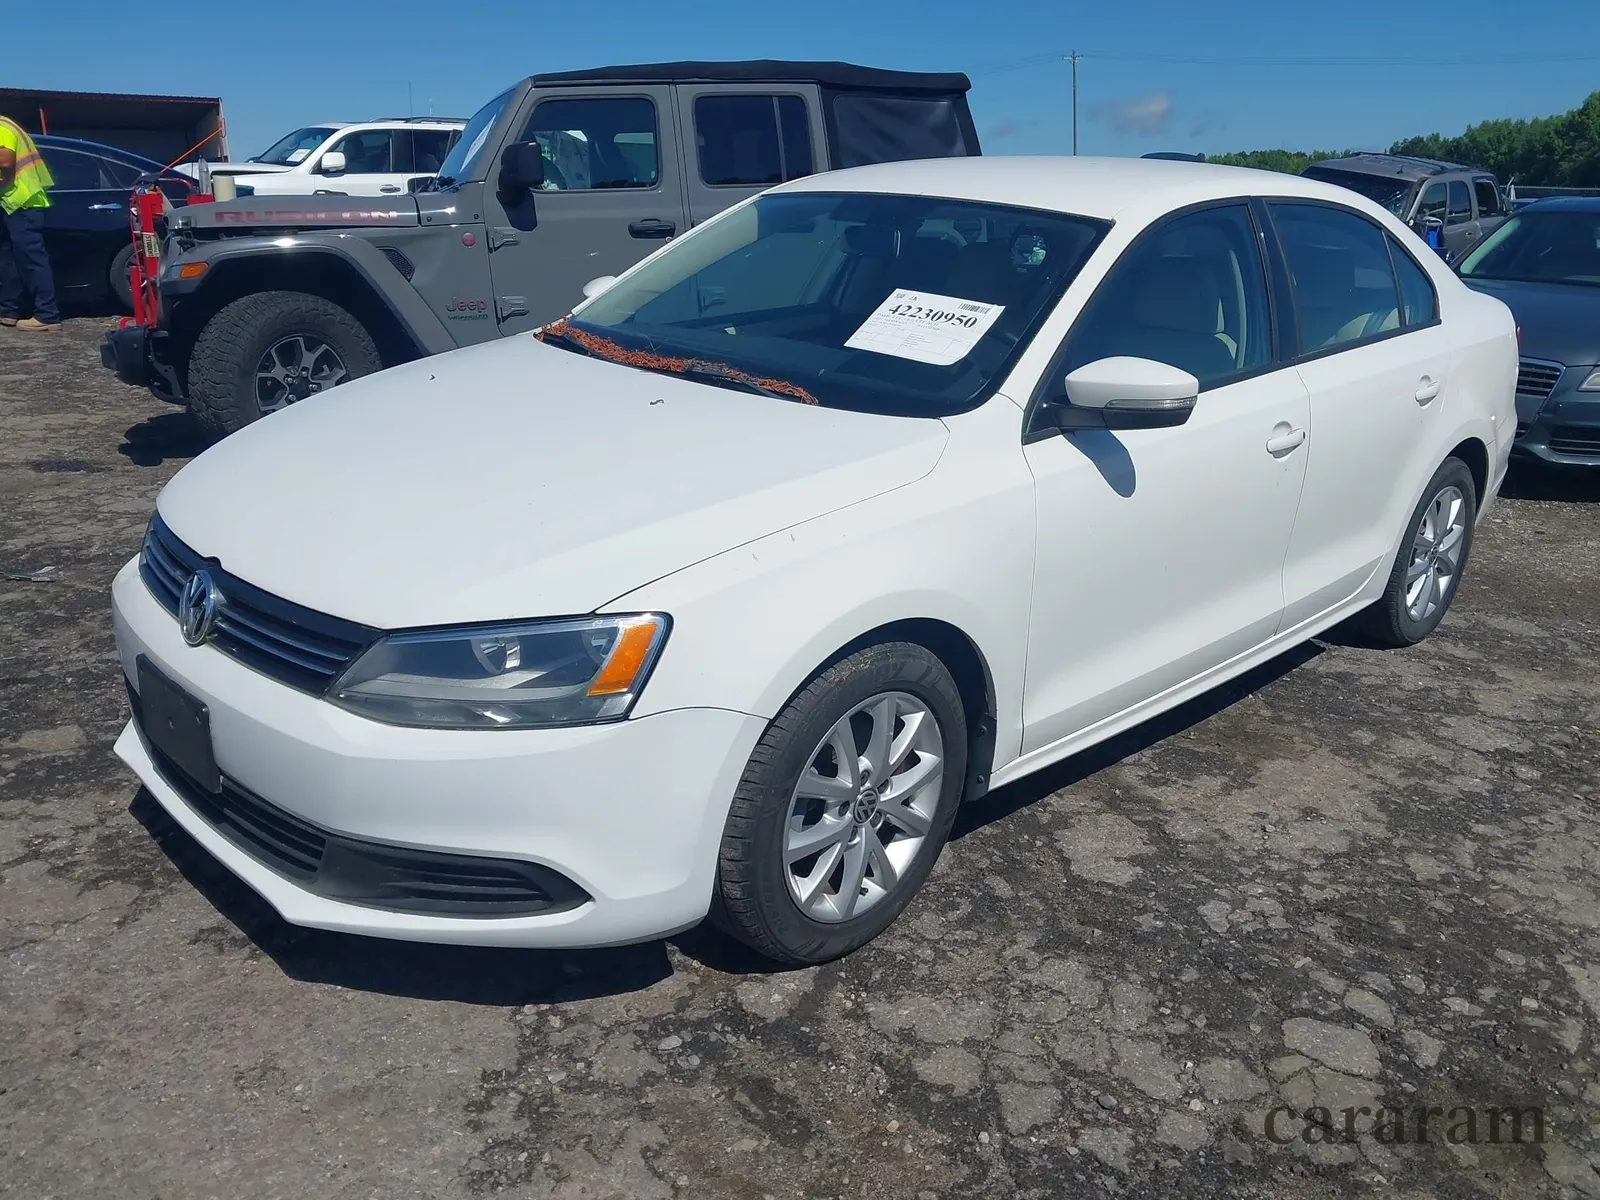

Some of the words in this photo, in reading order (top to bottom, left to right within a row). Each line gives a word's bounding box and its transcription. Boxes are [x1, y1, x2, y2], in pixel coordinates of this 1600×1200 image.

[214, 210, 398, 223] RUBICON
[446, 297, 488, 313] Jeep
[888, 303, 978, 329] 42230950
